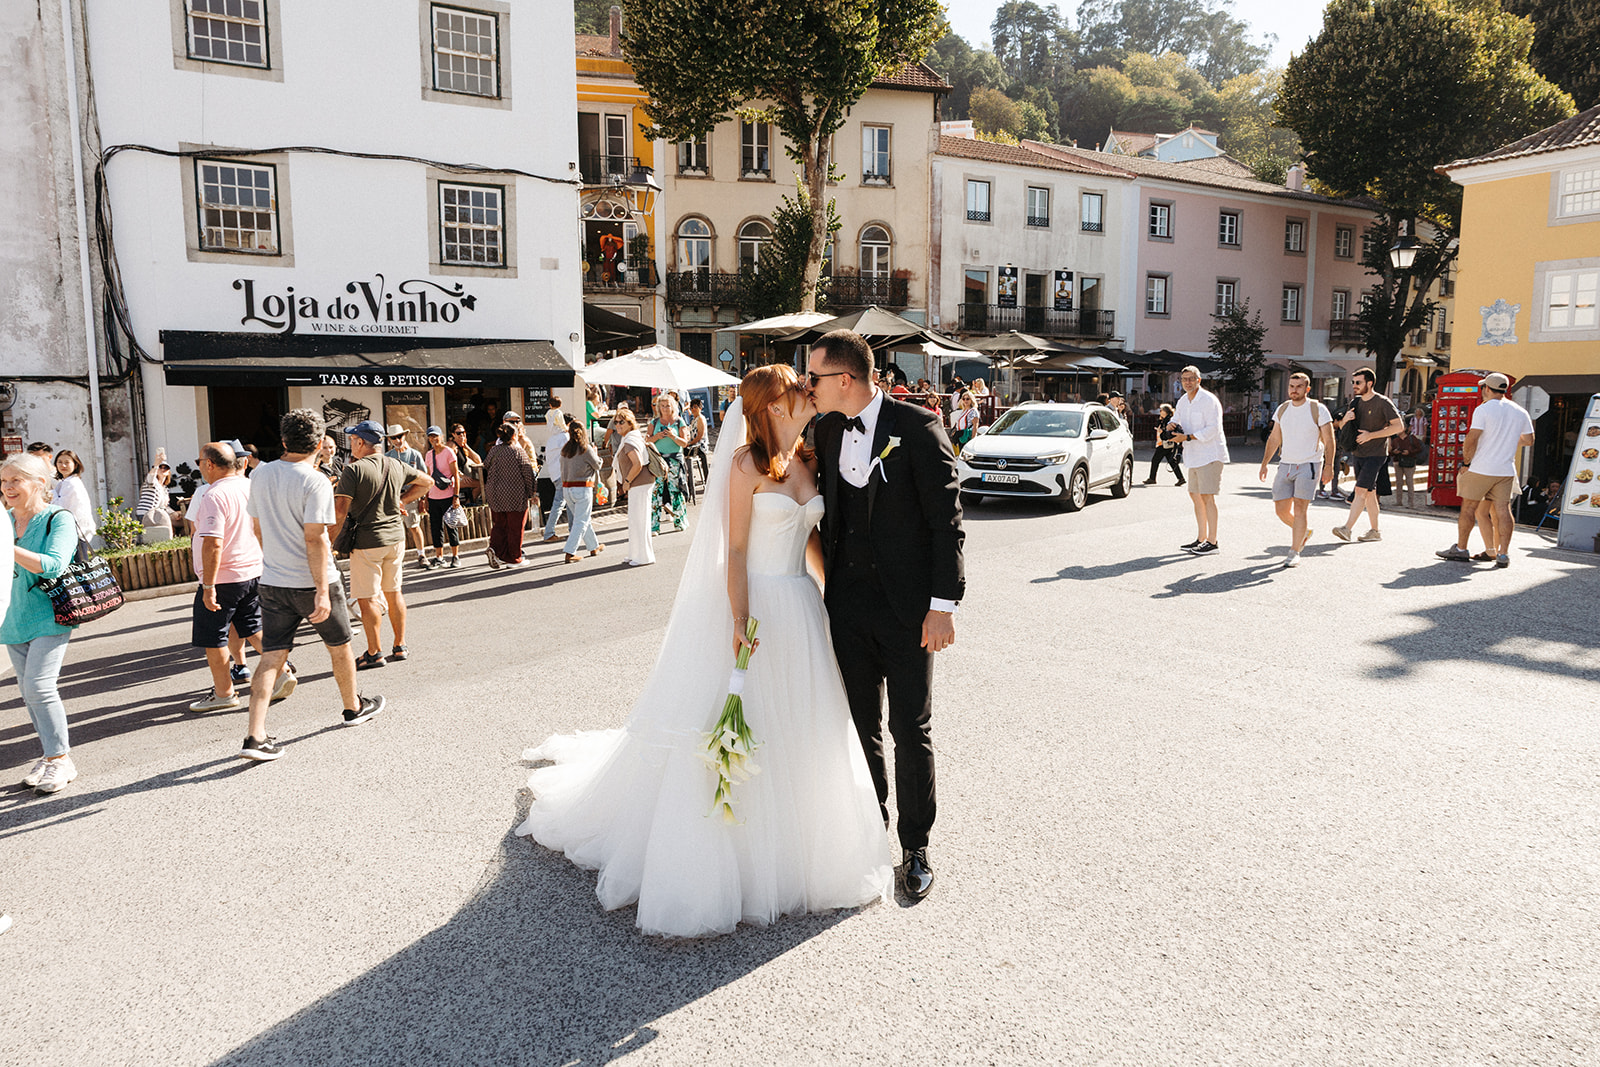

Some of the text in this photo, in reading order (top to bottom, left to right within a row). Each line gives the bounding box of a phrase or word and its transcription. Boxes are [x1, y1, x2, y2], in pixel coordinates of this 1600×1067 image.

[232, 273, 464, 335] Loja do Vinho
[311, 323, 419, 334] WINE & GOURMET
[319, 374, 455, 386] TAPAS & PETISCOS
